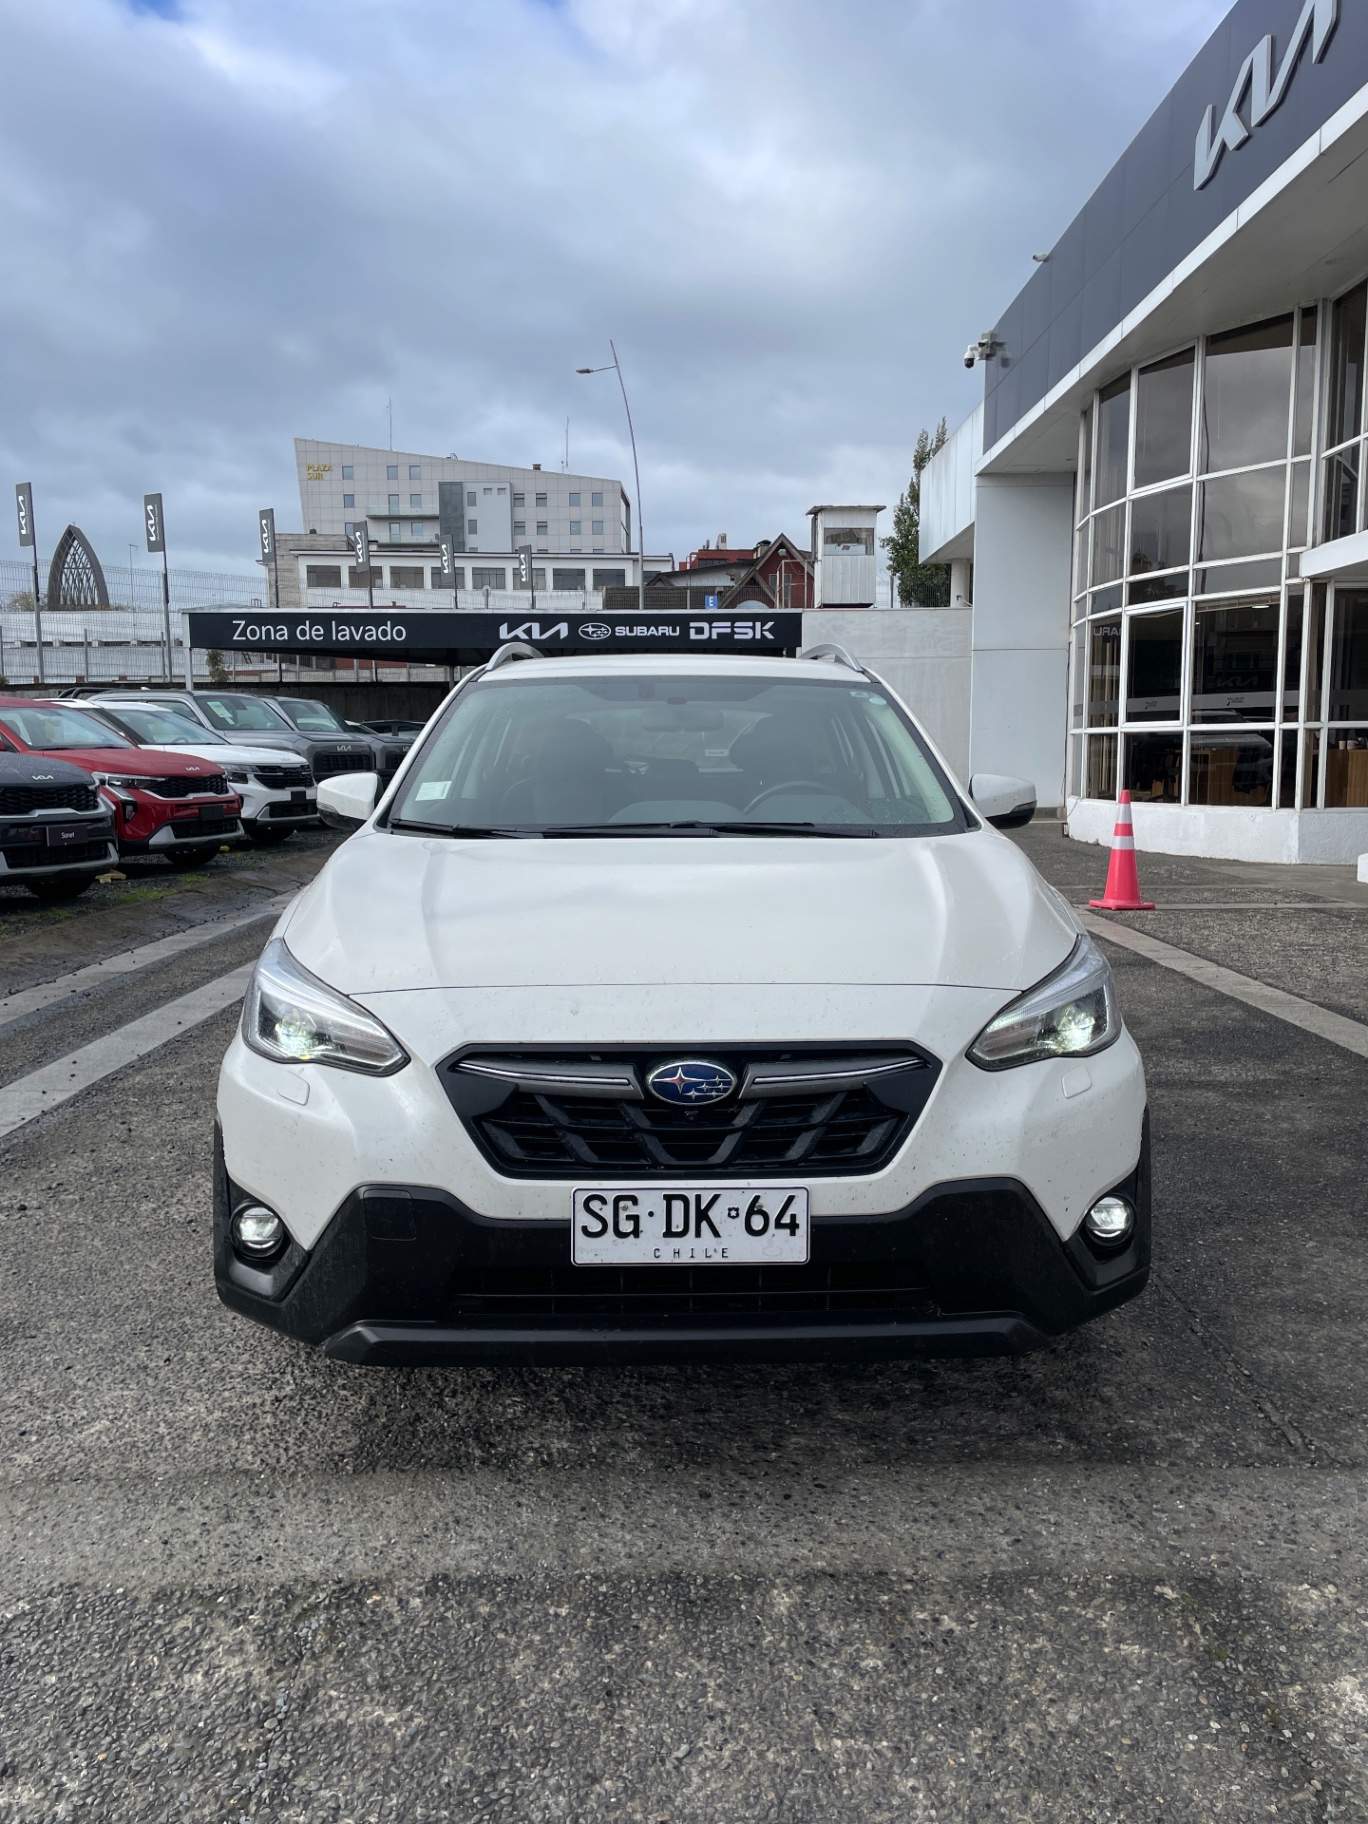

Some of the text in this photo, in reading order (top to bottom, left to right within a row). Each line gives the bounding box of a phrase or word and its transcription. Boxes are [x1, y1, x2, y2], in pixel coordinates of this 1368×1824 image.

[232, 619, 408, 641] Zona de lavado
[499, 621, 776, 640] KIA SUBARU DFSK
[653, 1247, 730, 1259] CHILE
